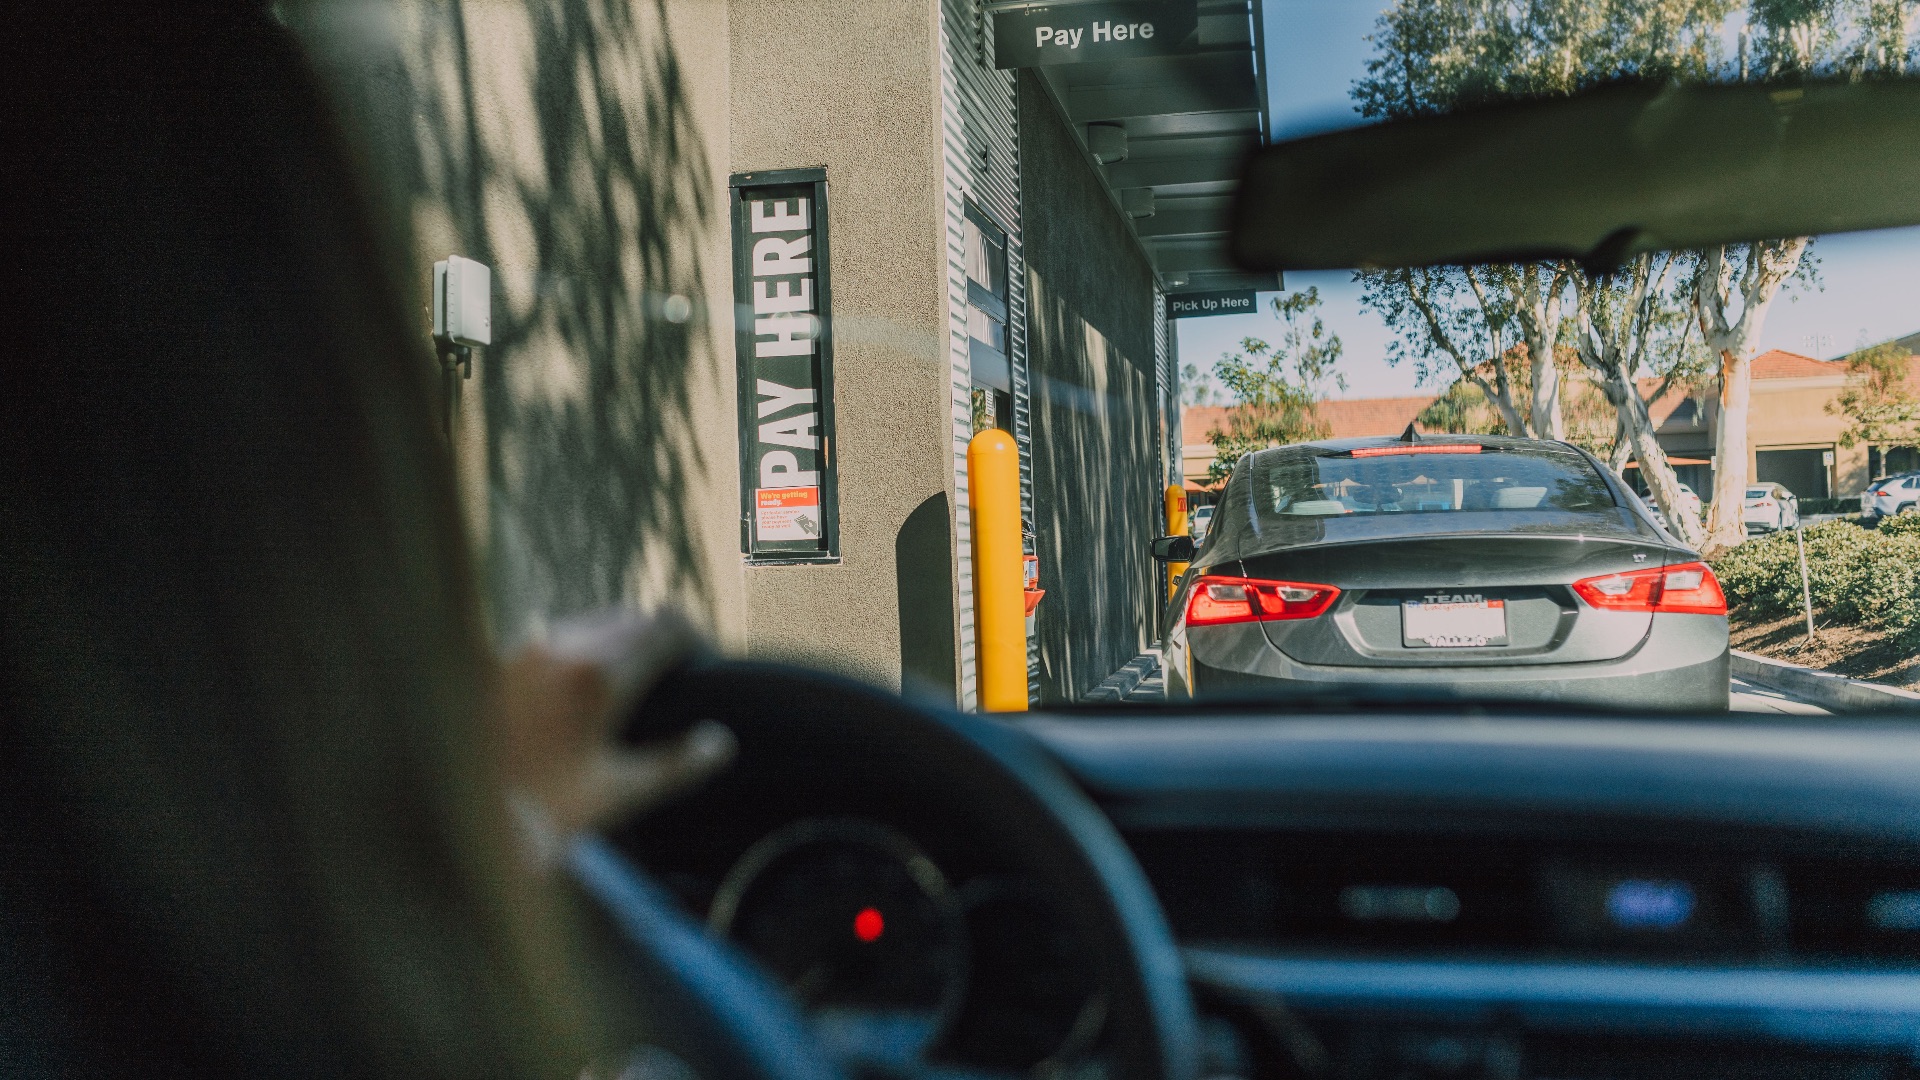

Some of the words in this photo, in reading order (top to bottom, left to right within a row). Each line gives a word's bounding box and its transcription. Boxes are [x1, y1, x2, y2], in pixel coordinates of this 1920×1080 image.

[1035, 25, 1084, 49] Pay
[1092, 20, 1155, 43] Here
[750, 197, 814, 358] HERE
[1173, 301, 1198, 311] Pick
[1202, 299, 1218, 311] Up
[1221, 297, 1250, 308] Here
[756, 378, 818, 488] PAY
[781, 490, 808, 499] getting
[1424, 594, 1484, 604] TEAM
